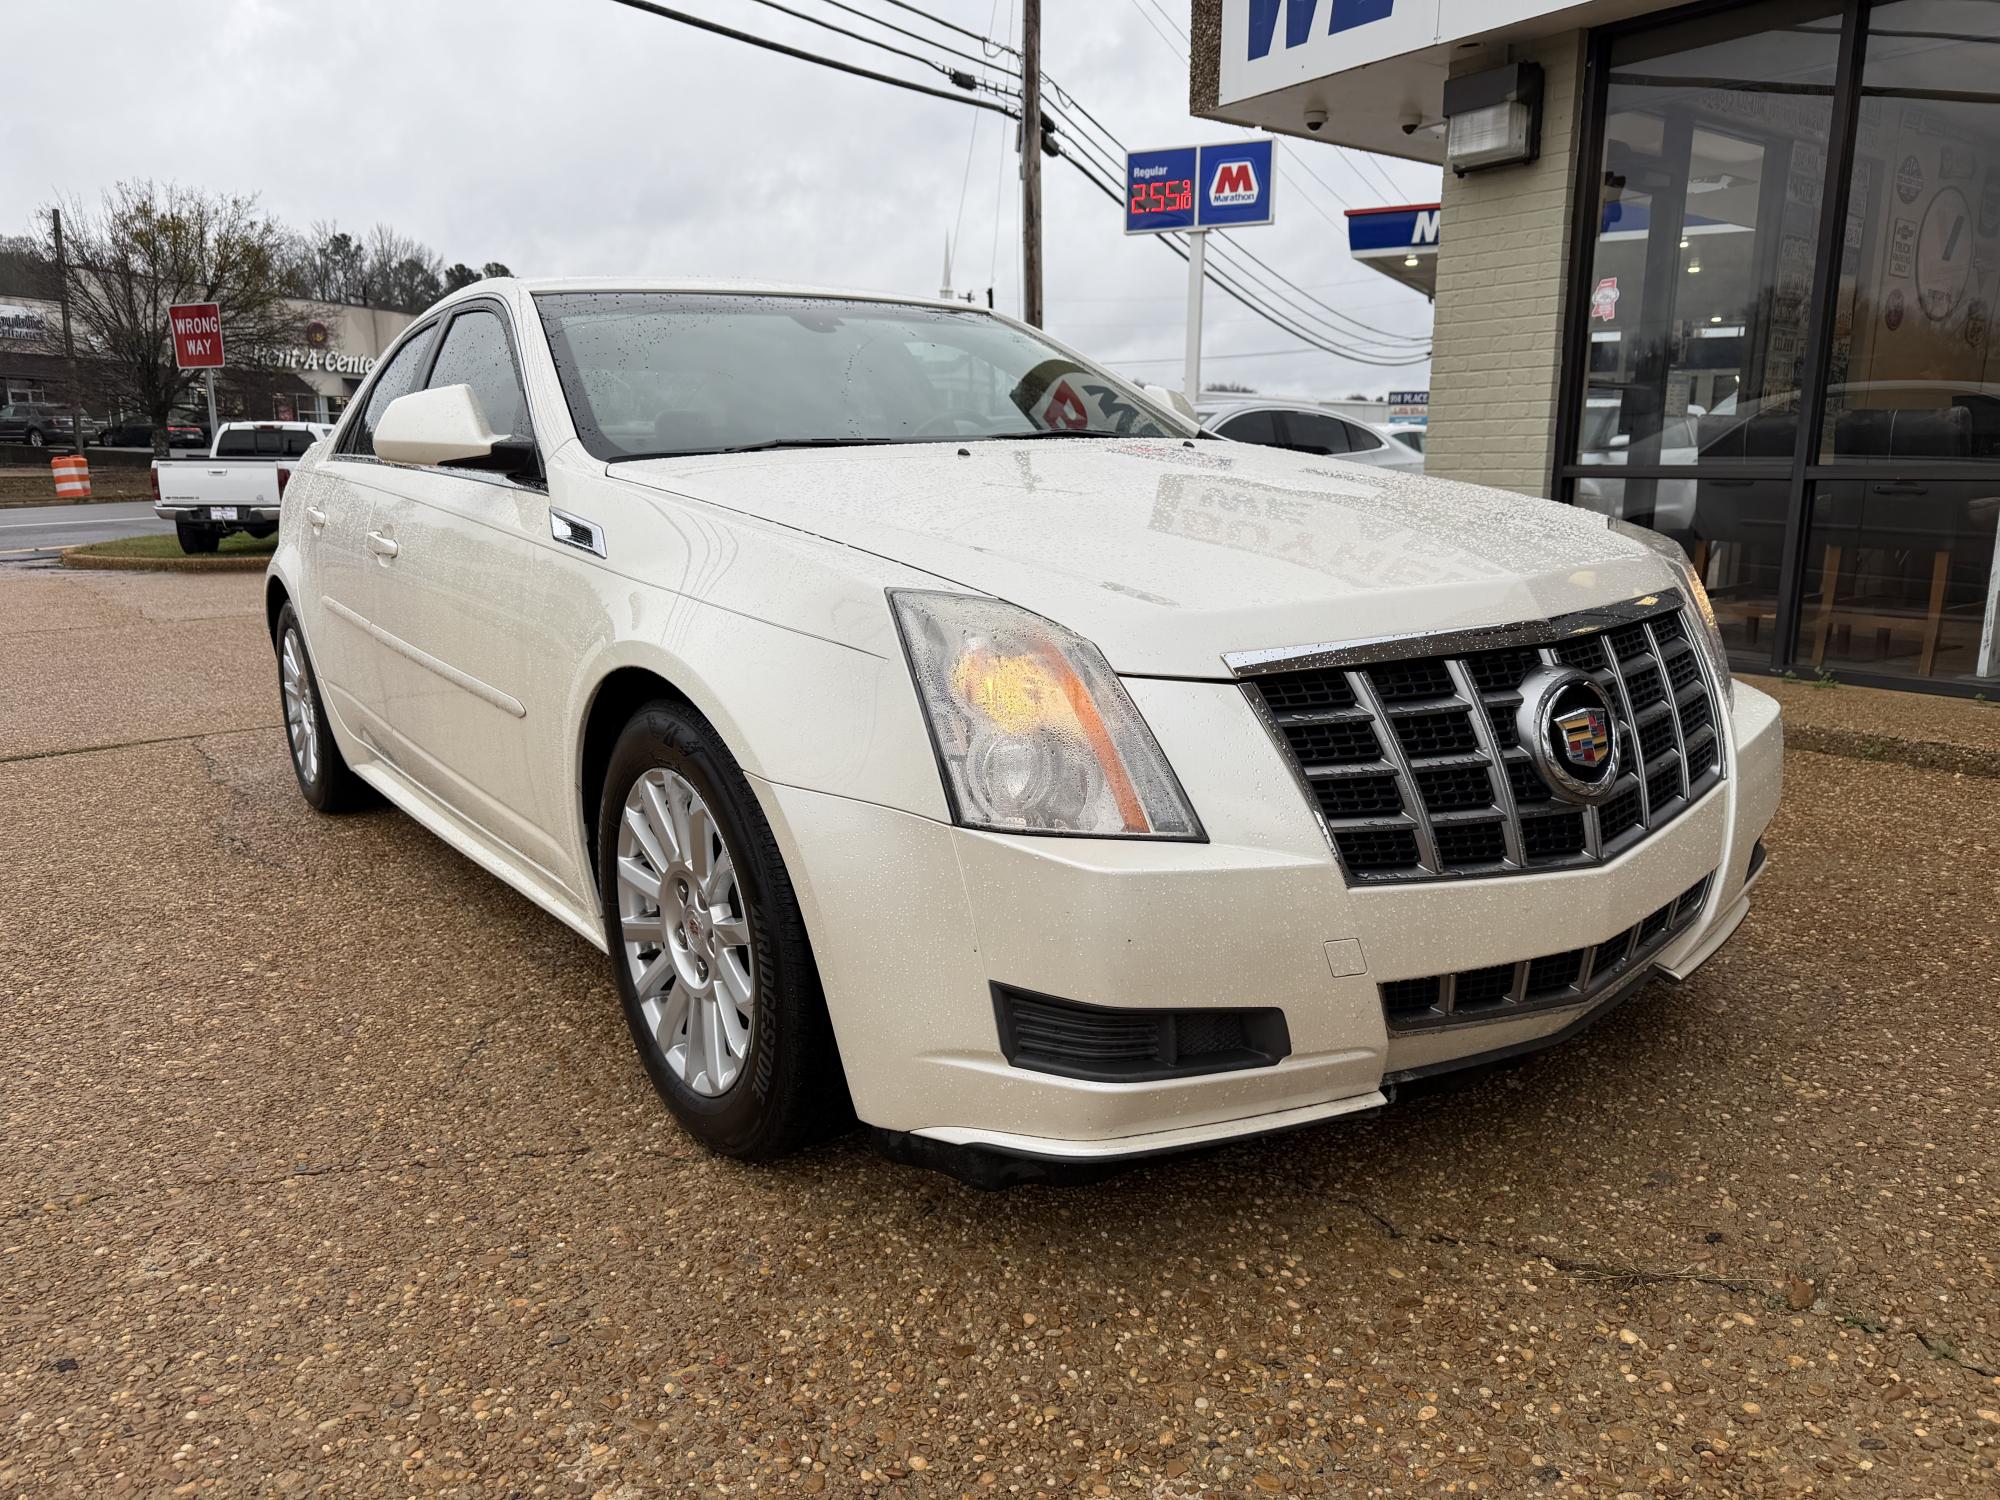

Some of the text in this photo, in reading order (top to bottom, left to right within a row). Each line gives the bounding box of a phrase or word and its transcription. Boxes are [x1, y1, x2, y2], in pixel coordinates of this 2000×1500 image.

[1133, 165, 1168, 179] Regular
[1131, 181, 1180, 214] 2.55
[1214, 193, 1254, 203] Marathon
[175, 316, 218, 335] WRONG
[186, 338, 211, 356] WAY
